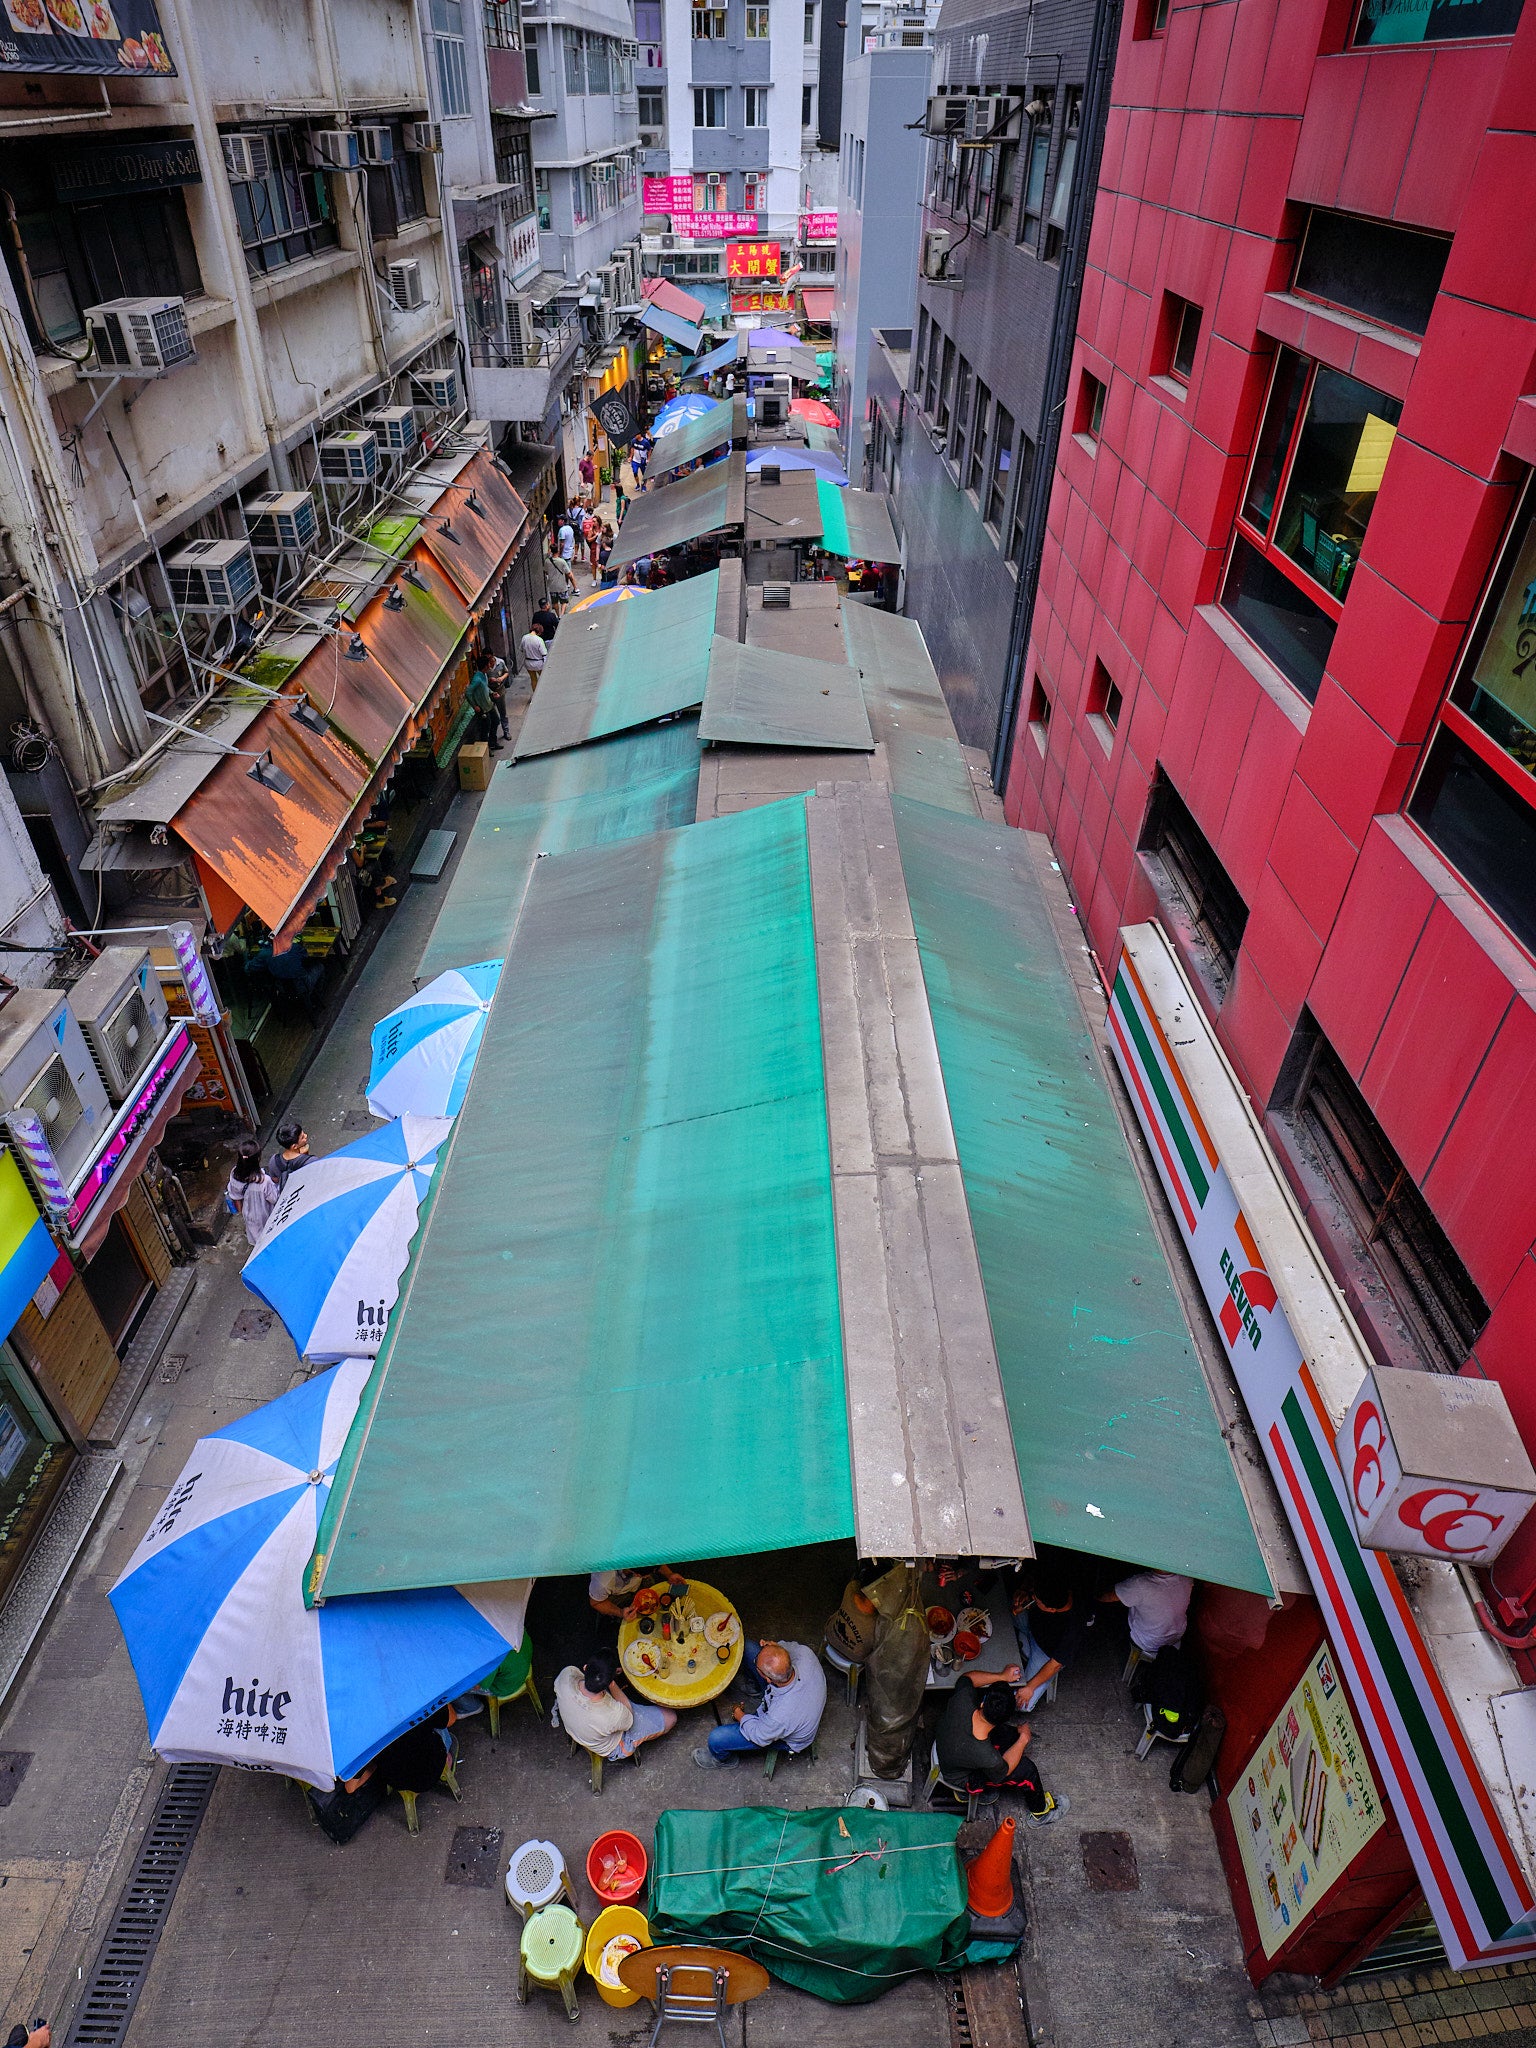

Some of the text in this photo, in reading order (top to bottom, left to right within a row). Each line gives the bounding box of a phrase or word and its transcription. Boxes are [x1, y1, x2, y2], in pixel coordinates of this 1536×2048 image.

[115, 155, 138, 182] CD
[138, 154, 162, 184] Buy
[165, 151, 177, 176] &
[176, 149, 200, 174] Sell
[729, 258, 778, 276] 大閘蟹
[737, 244, 771, 256] 三陽號
[386, 1020, 403, 1059] hite
[276, 1185, 305, 1226] hite
[356, 1298, 389, 1326] hi
[159, 1472, 203, 1534] hite
[222, 1676, 292, 1721] hite
[216, 1718, 288, 1745] 海特啤酒
